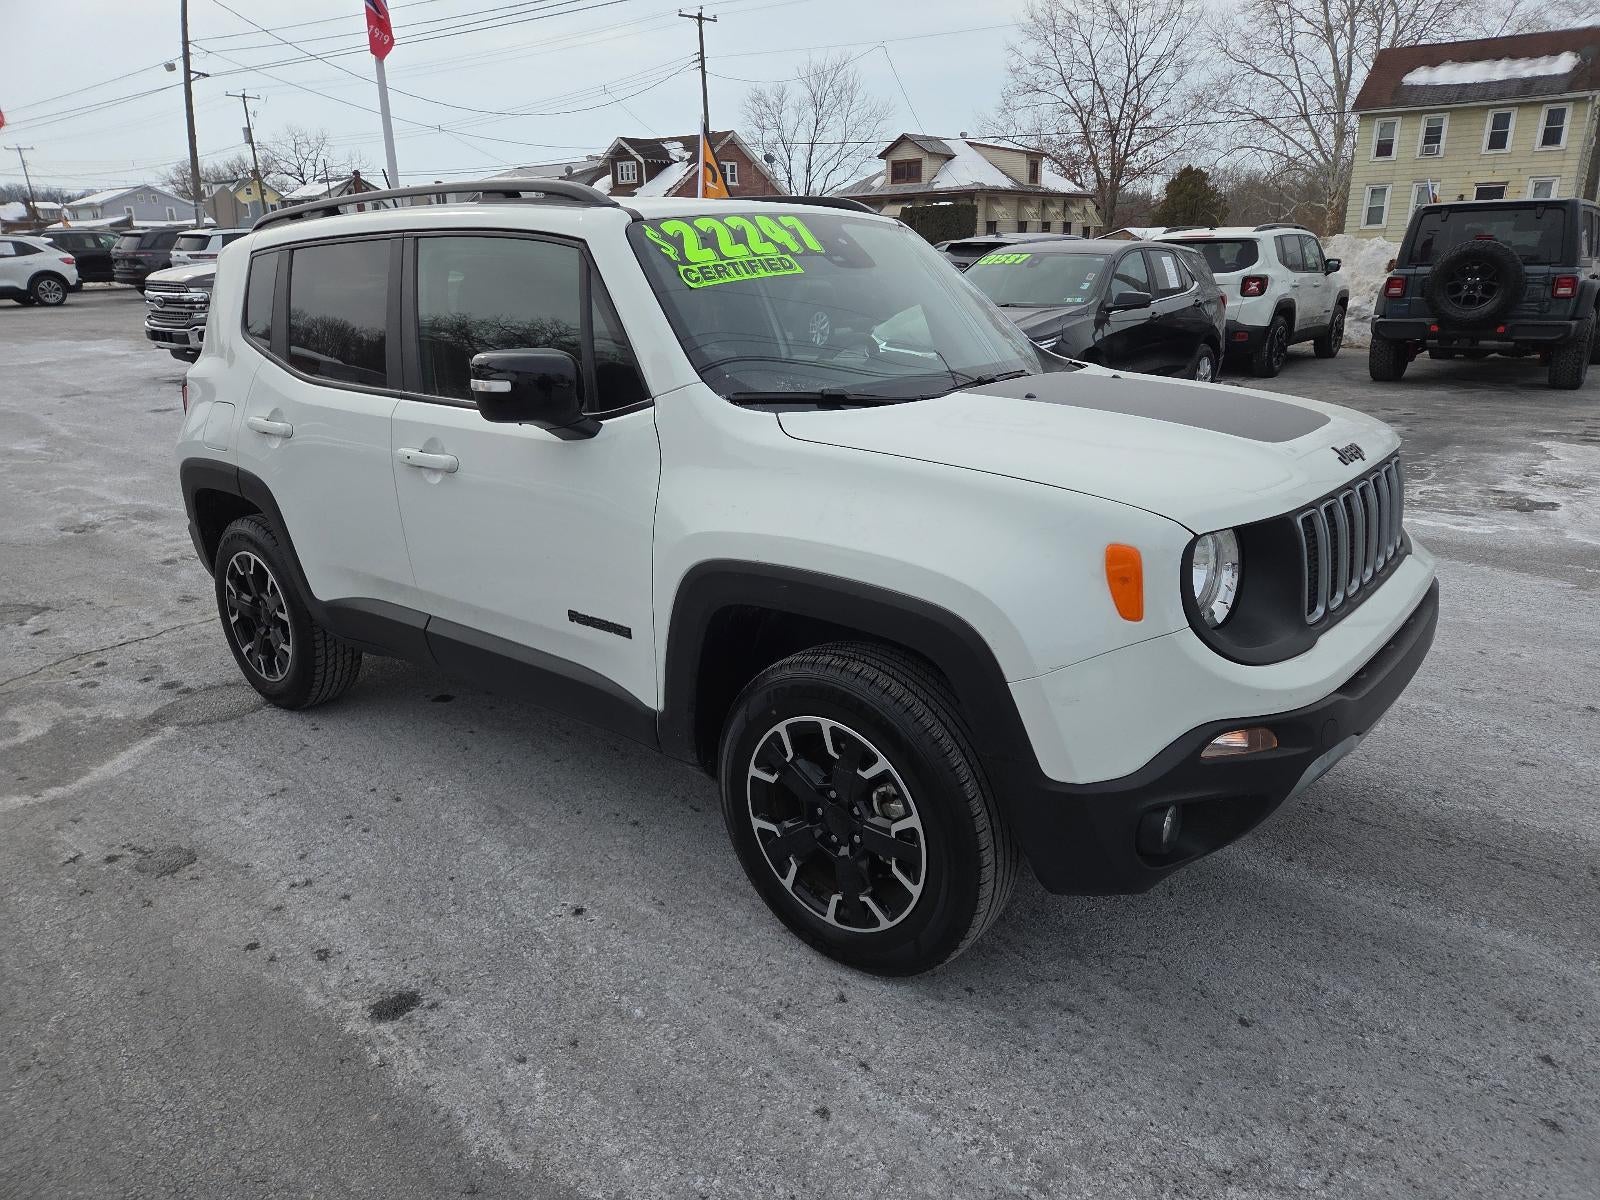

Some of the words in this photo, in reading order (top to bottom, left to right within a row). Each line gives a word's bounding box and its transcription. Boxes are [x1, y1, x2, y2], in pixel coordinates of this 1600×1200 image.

[642, 215, 825, 263] $22247
[682, 256, 797, 284] CERTIFIED
[1331, 443, 1366, 465] Jeep
